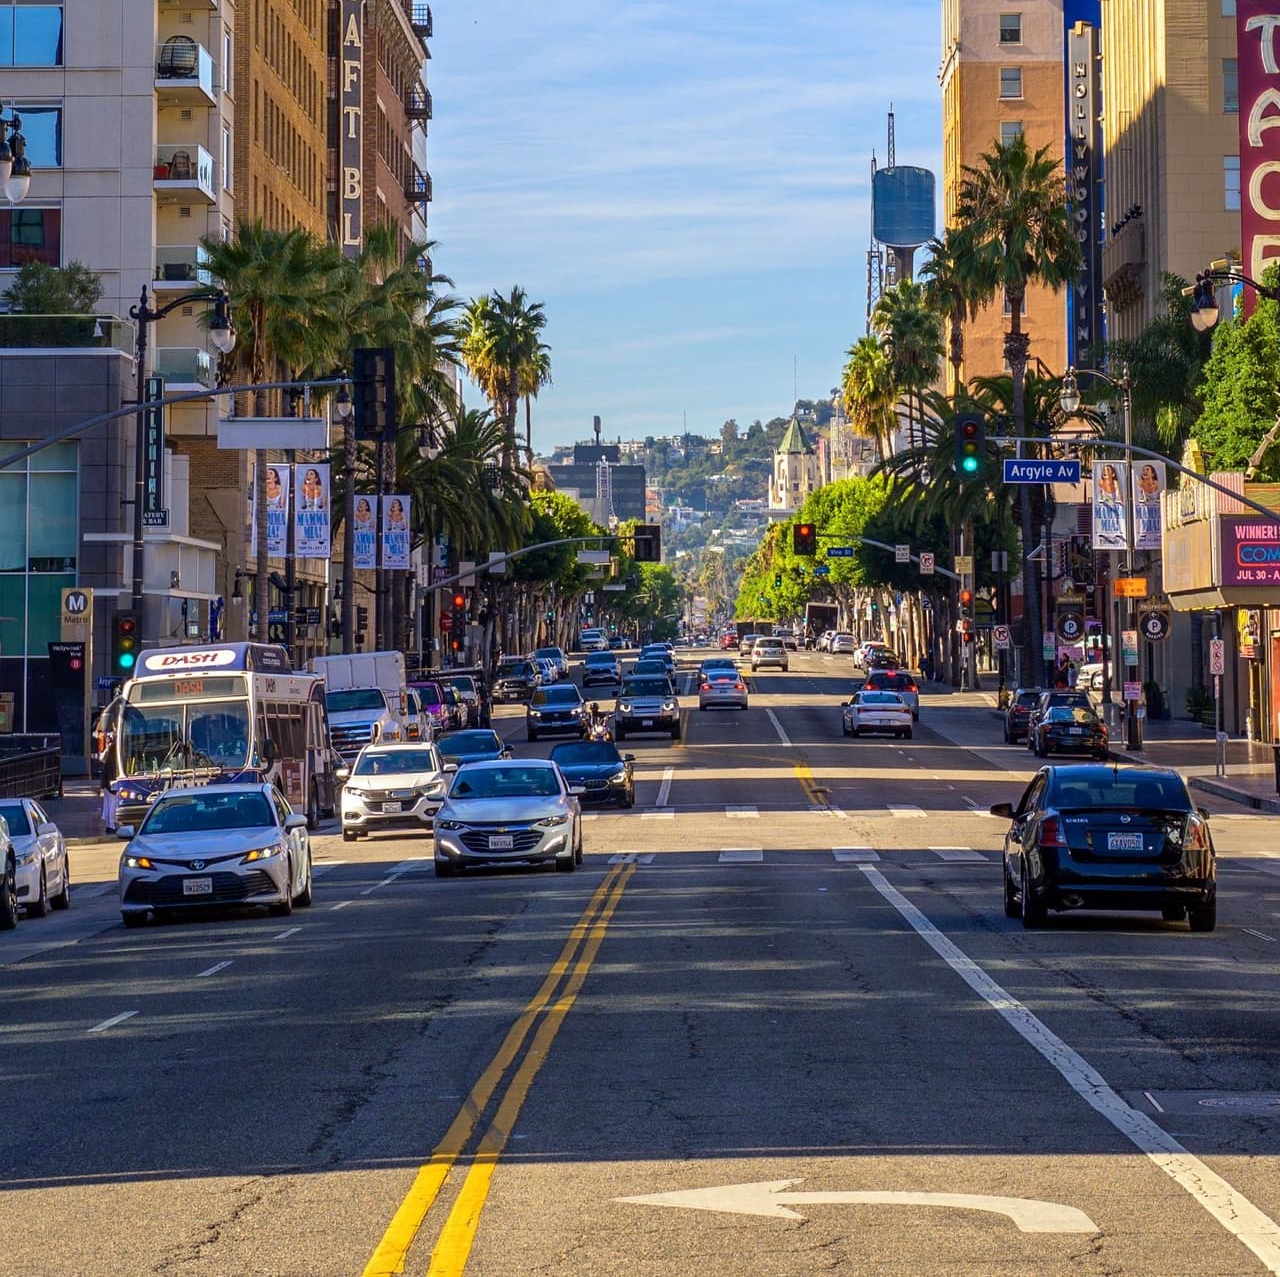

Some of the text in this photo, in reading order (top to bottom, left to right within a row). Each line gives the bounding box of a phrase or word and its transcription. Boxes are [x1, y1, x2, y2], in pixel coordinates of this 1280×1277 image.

[1074, 62, 1089, 244] HOLLYWOOD
[1011, 465, 1073, 480] Argyle Av
[297, 513, 328, 525] MAMMA
[303, 526, 322, 538] MIA!
[1235, 526, 1277, 539] WINNER!
[1237, 570, 1254, 580] JUL
[1256, 570, 1266, 580] 30
[69, 595, 84, 610] M
[161, 652, 218, 666] DASH
[174, 680, 203, 694] DASH
